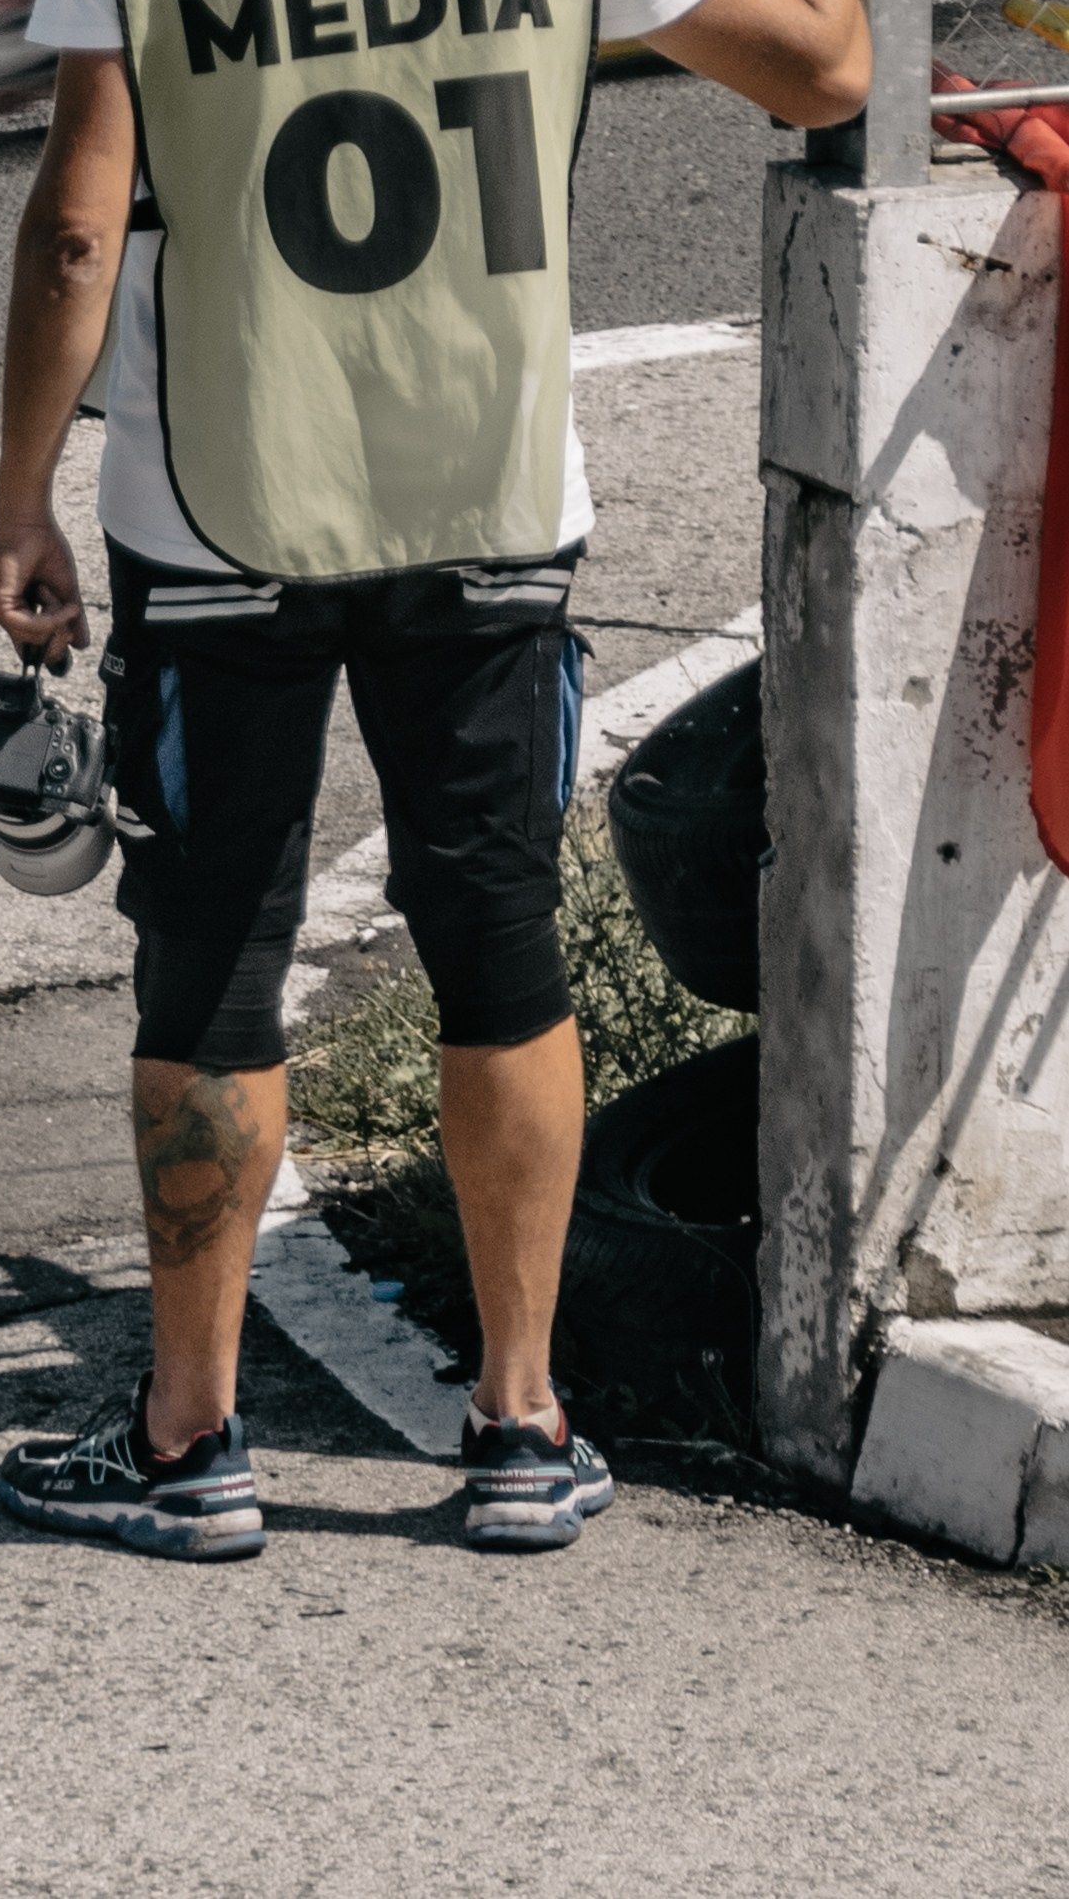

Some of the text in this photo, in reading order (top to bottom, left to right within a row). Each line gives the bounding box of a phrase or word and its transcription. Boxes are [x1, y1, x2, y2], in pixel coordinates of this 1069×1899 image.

[263, 70, 548, 295] 01
[490, 1467, 535, 1479] MARTINI
[490, 1481, 535, 1493] RACING
